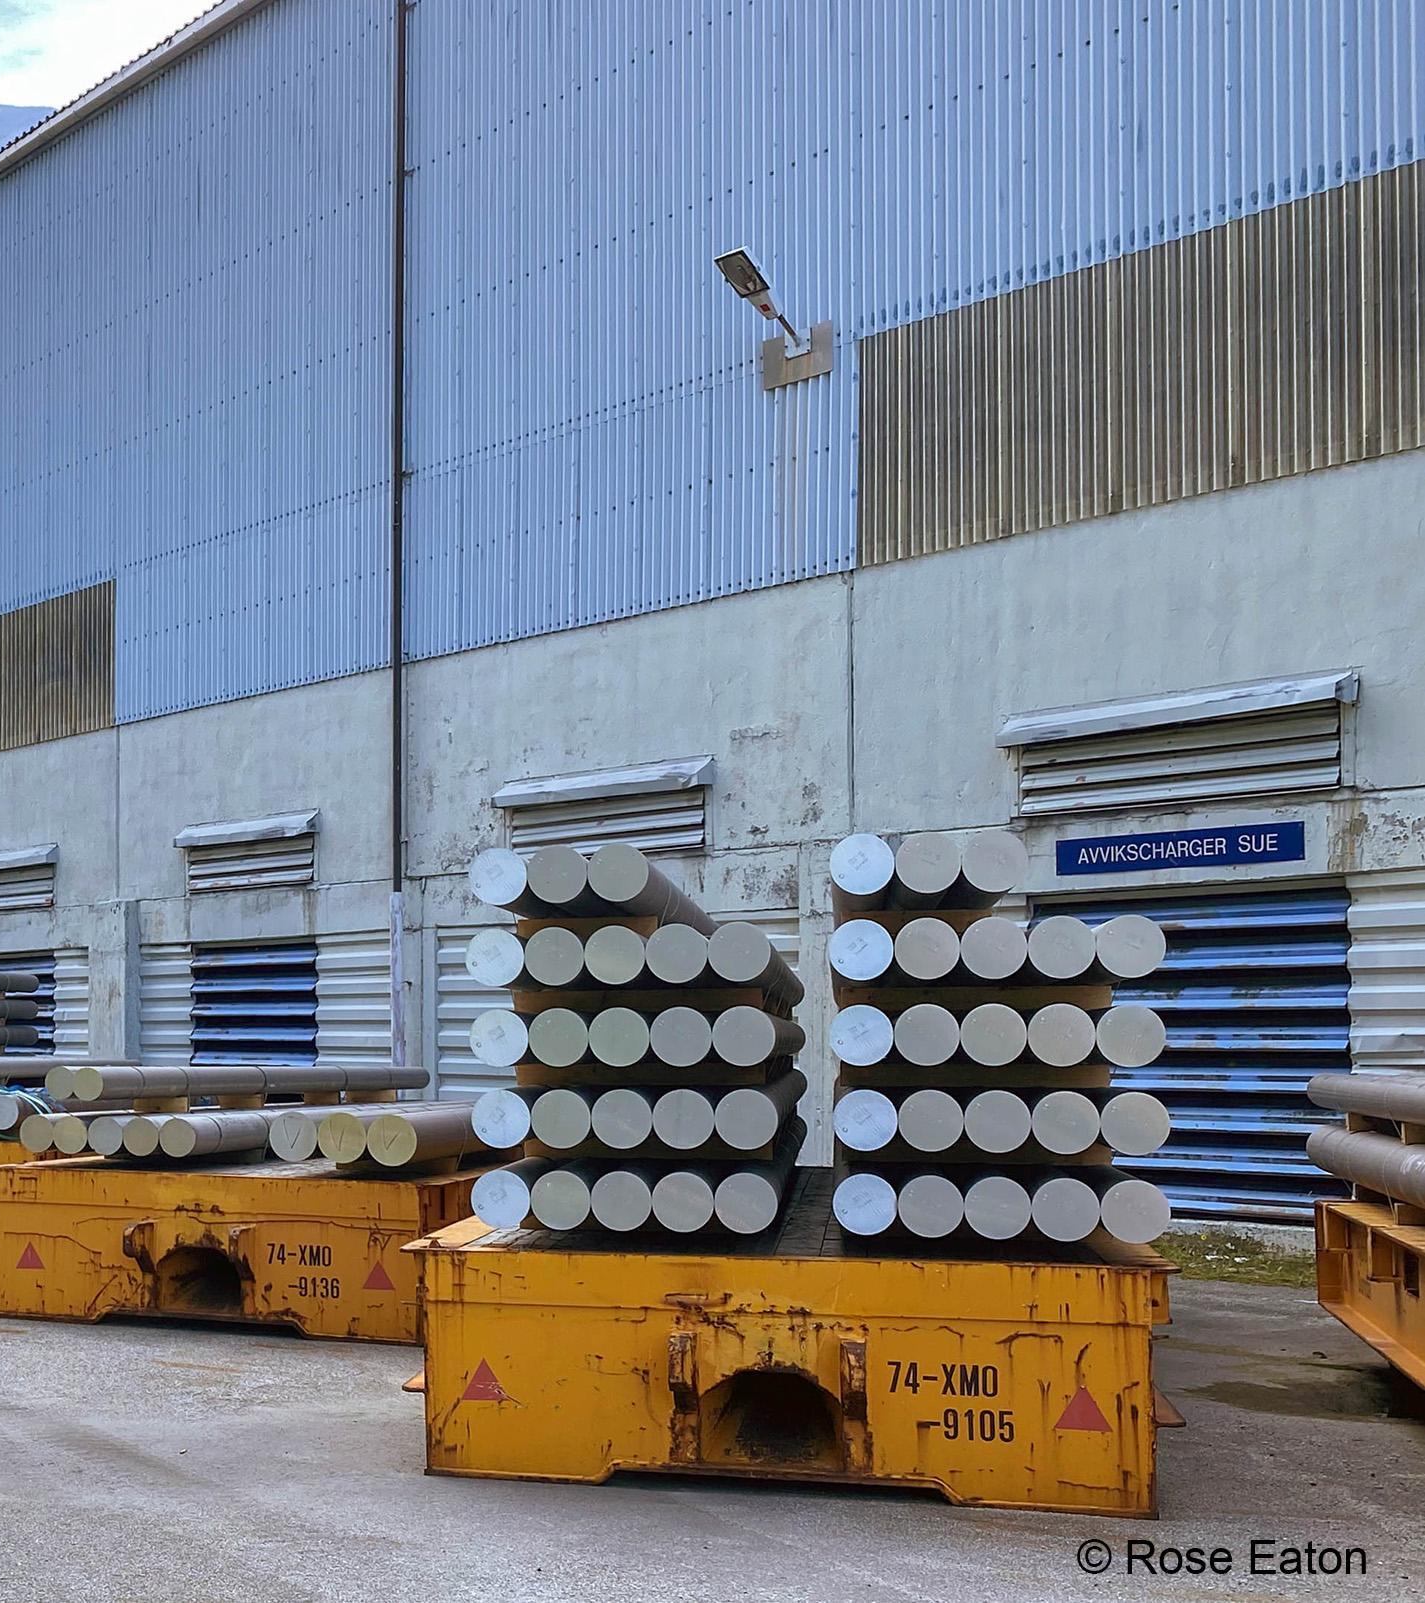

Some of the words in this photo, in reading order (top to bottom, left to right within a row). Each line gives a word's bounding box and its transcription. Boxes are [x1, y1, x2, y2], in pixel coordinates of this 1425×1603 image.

[1078, 837, 1227, 864] AVVIKSCHARGER
[1238, 833, 1279, 853] SUE
[288, 1276, 340, 1299] -9136
[923, 1408, 1015, 1443] -9105
